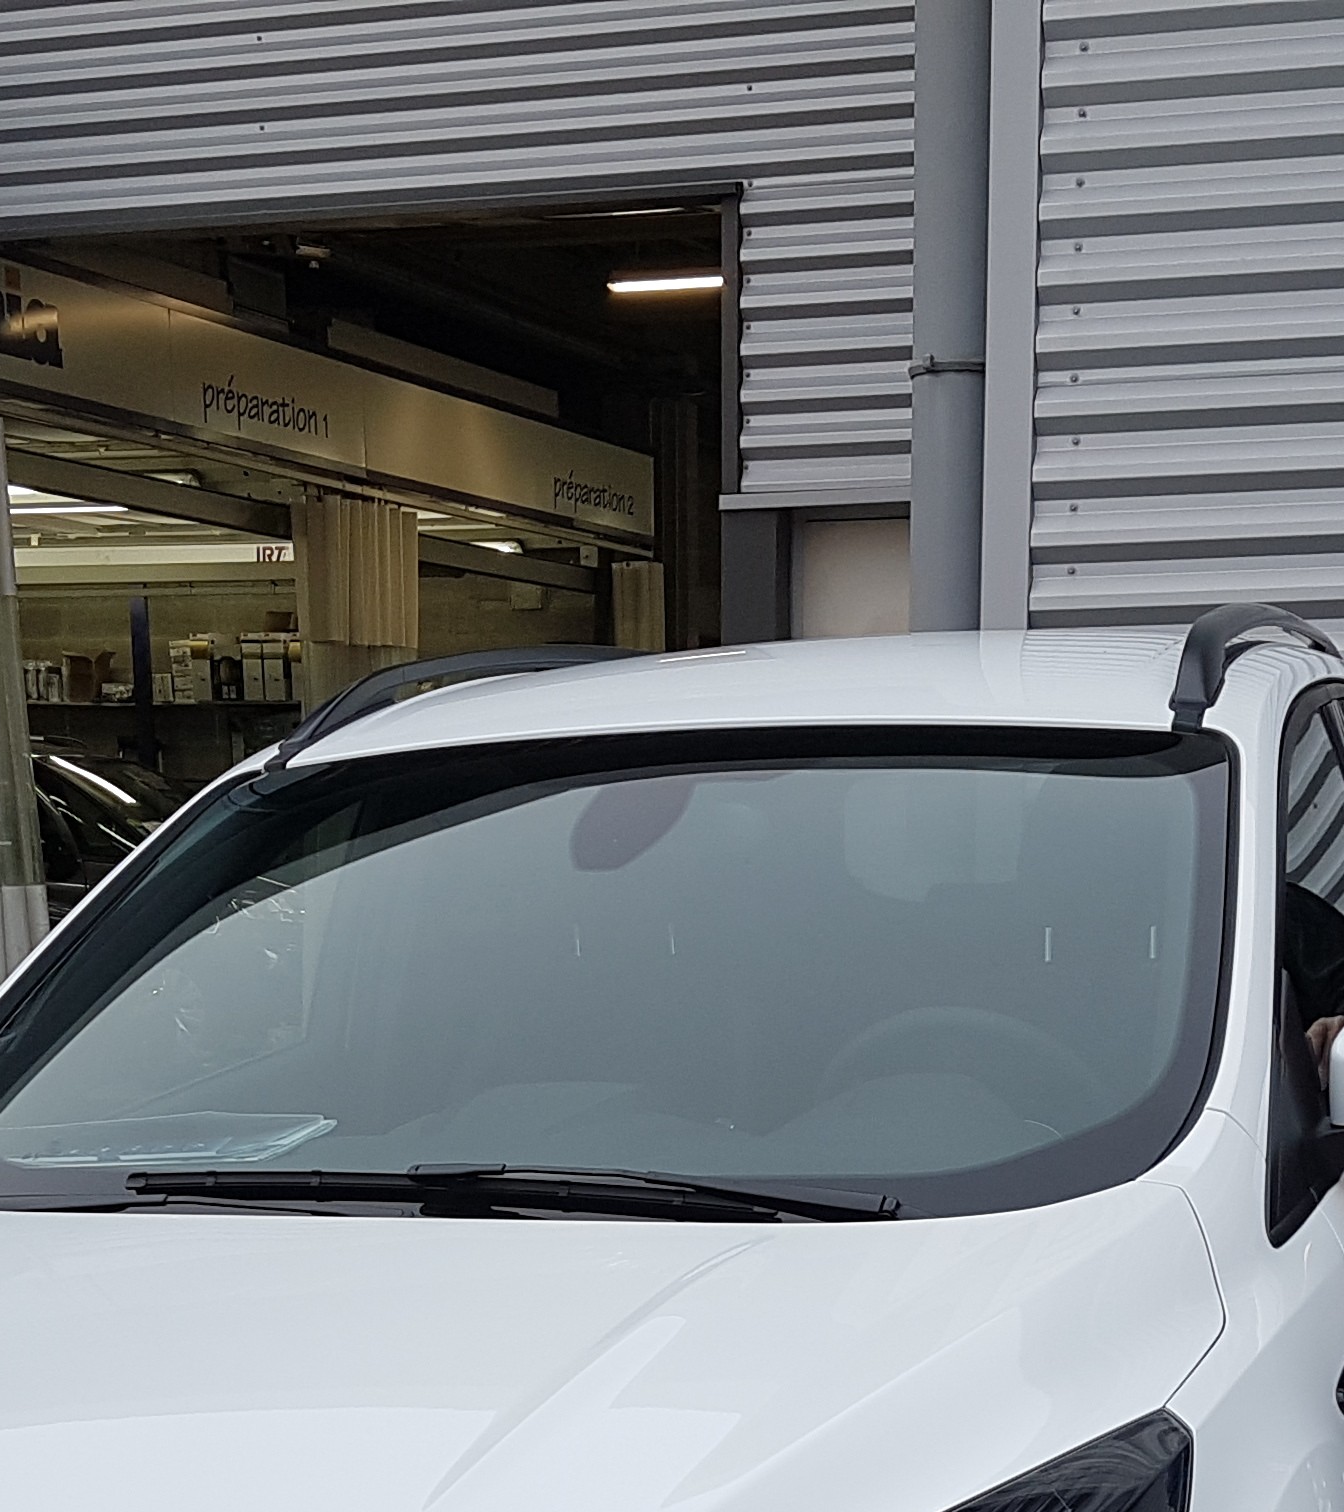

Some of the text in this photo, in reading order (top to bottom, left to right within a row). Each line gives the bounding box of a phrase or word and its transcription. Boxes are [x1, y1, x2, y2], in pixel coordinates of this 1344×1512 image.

[202, 375, 328, 438] préparation 1
[553, 470, 625, 513] préparation
